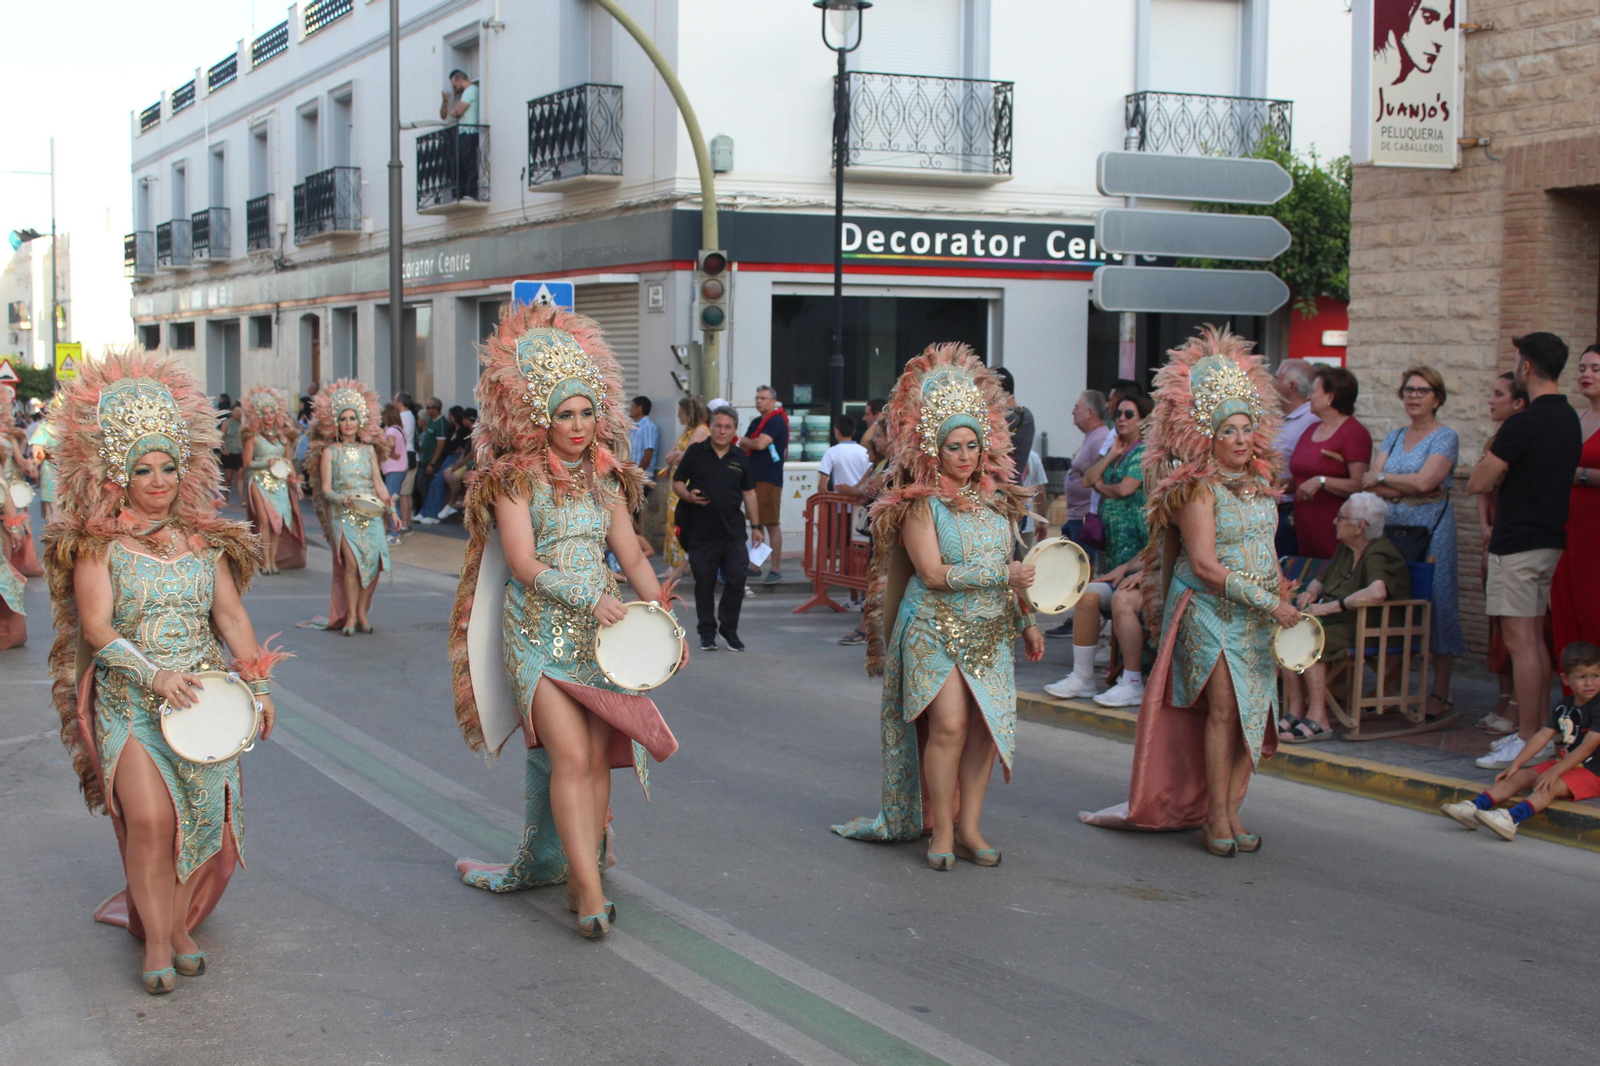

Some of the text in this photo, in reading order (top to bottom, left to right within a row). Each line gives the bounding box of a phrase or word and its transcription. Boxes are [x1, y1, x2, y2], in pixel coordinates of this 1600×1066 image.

[1381, 126, 1444, 141] PELUQUERIA
[1381, 141, 1443, 153] DE CABALLEROS
[841, 222, 1026, 257] Decorator
[438, 252, 471, 274] Centre
